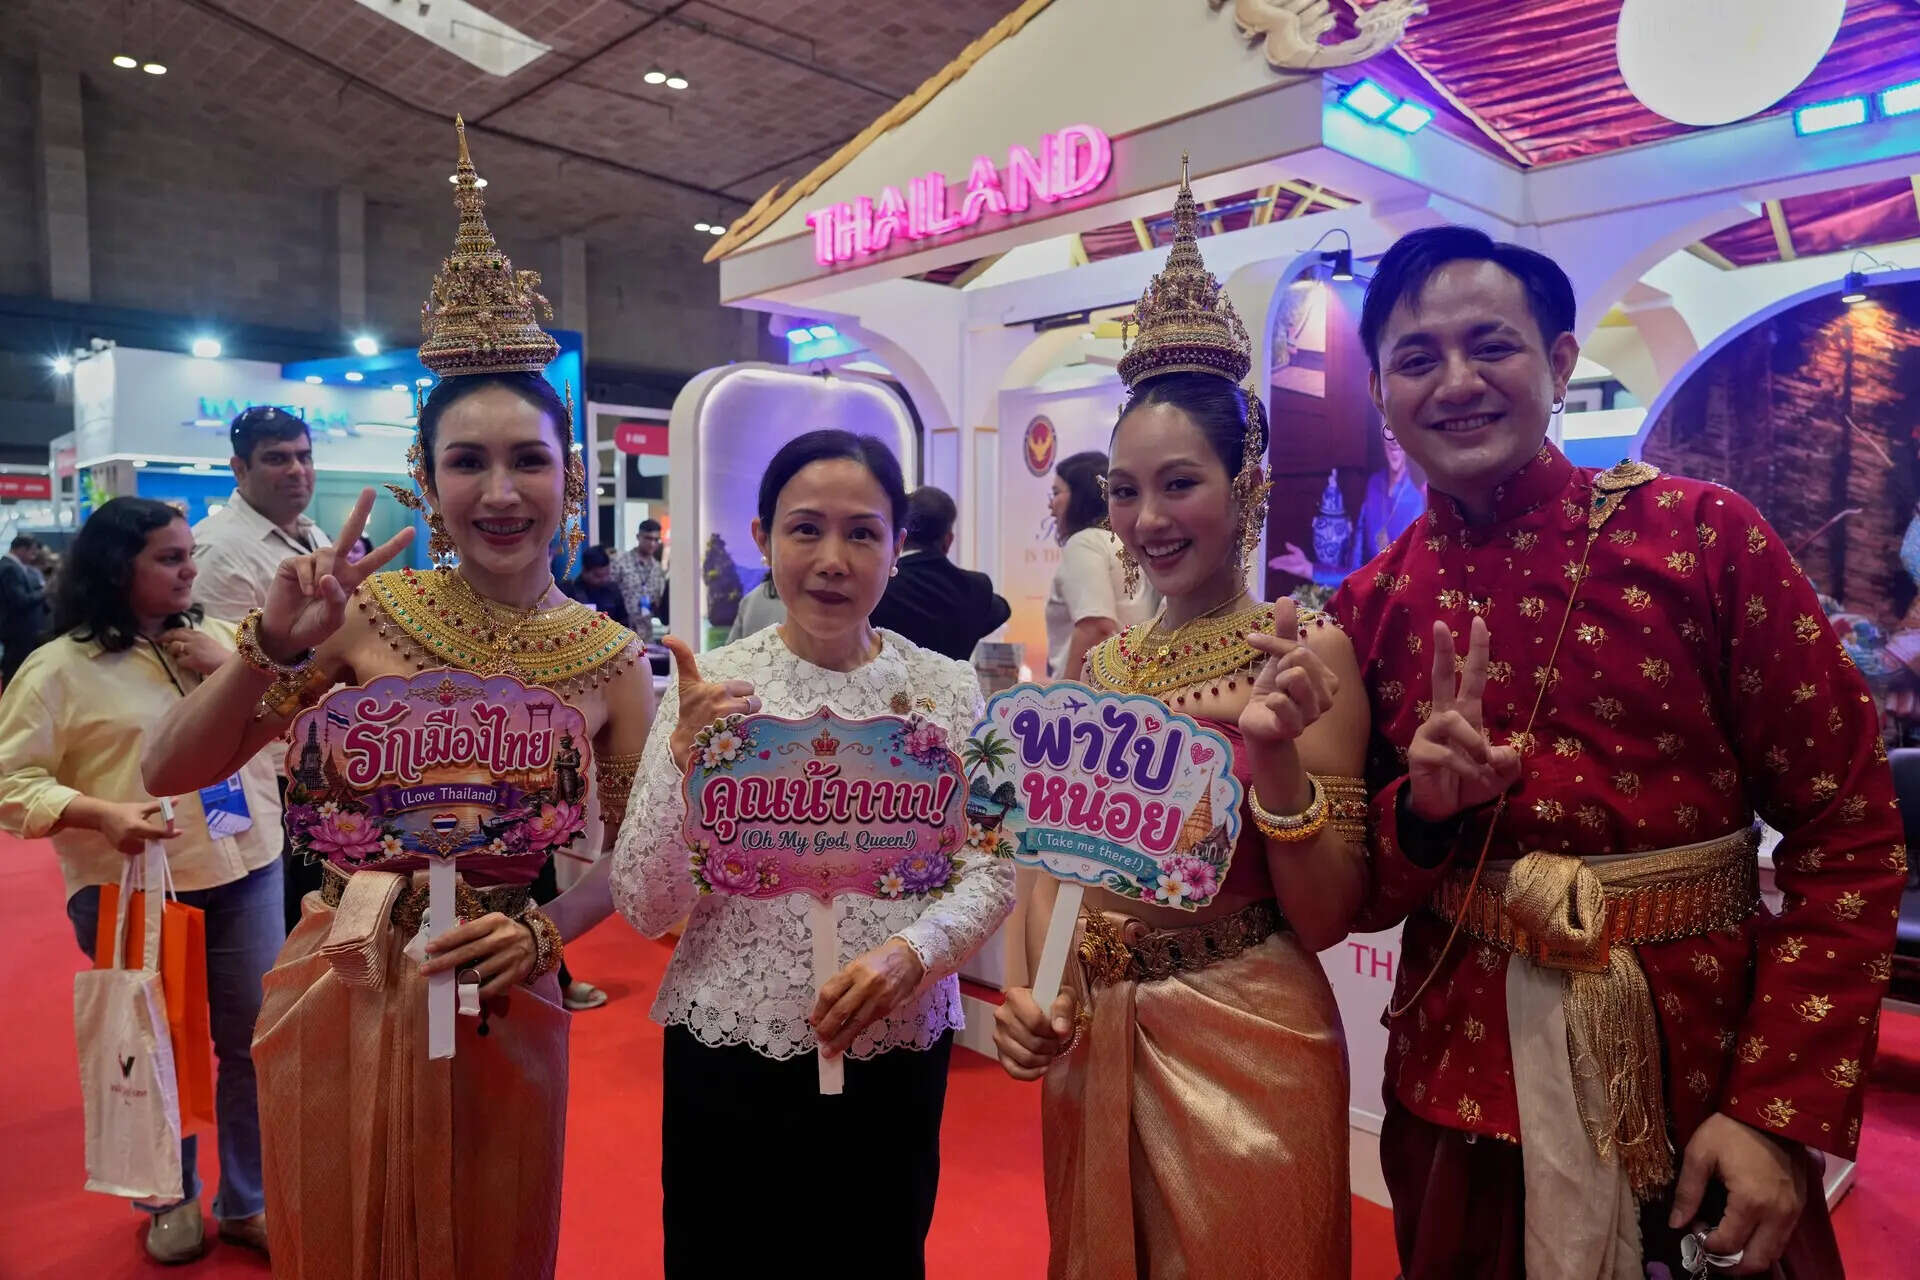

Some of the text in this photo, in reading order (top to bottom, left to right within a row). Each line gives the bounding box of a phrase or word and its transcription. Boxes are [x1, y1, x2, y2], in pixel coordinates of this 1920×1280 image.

[805, 123, 1112, 266] THAILAND
[344, 698, 553, 786] รักเมืองไทย
[1010, 704, 1184, 794] พาไป
[401, 787, 497, 807] (Love Thailand)
[1021, 771, 1184, 853] หน่อย
[742, 829, 918, 855] (Oh My God, Queen!)
[1038, 832, 1144, 872] (Take me there!)
[1347, 941, 1393, 982] TH
